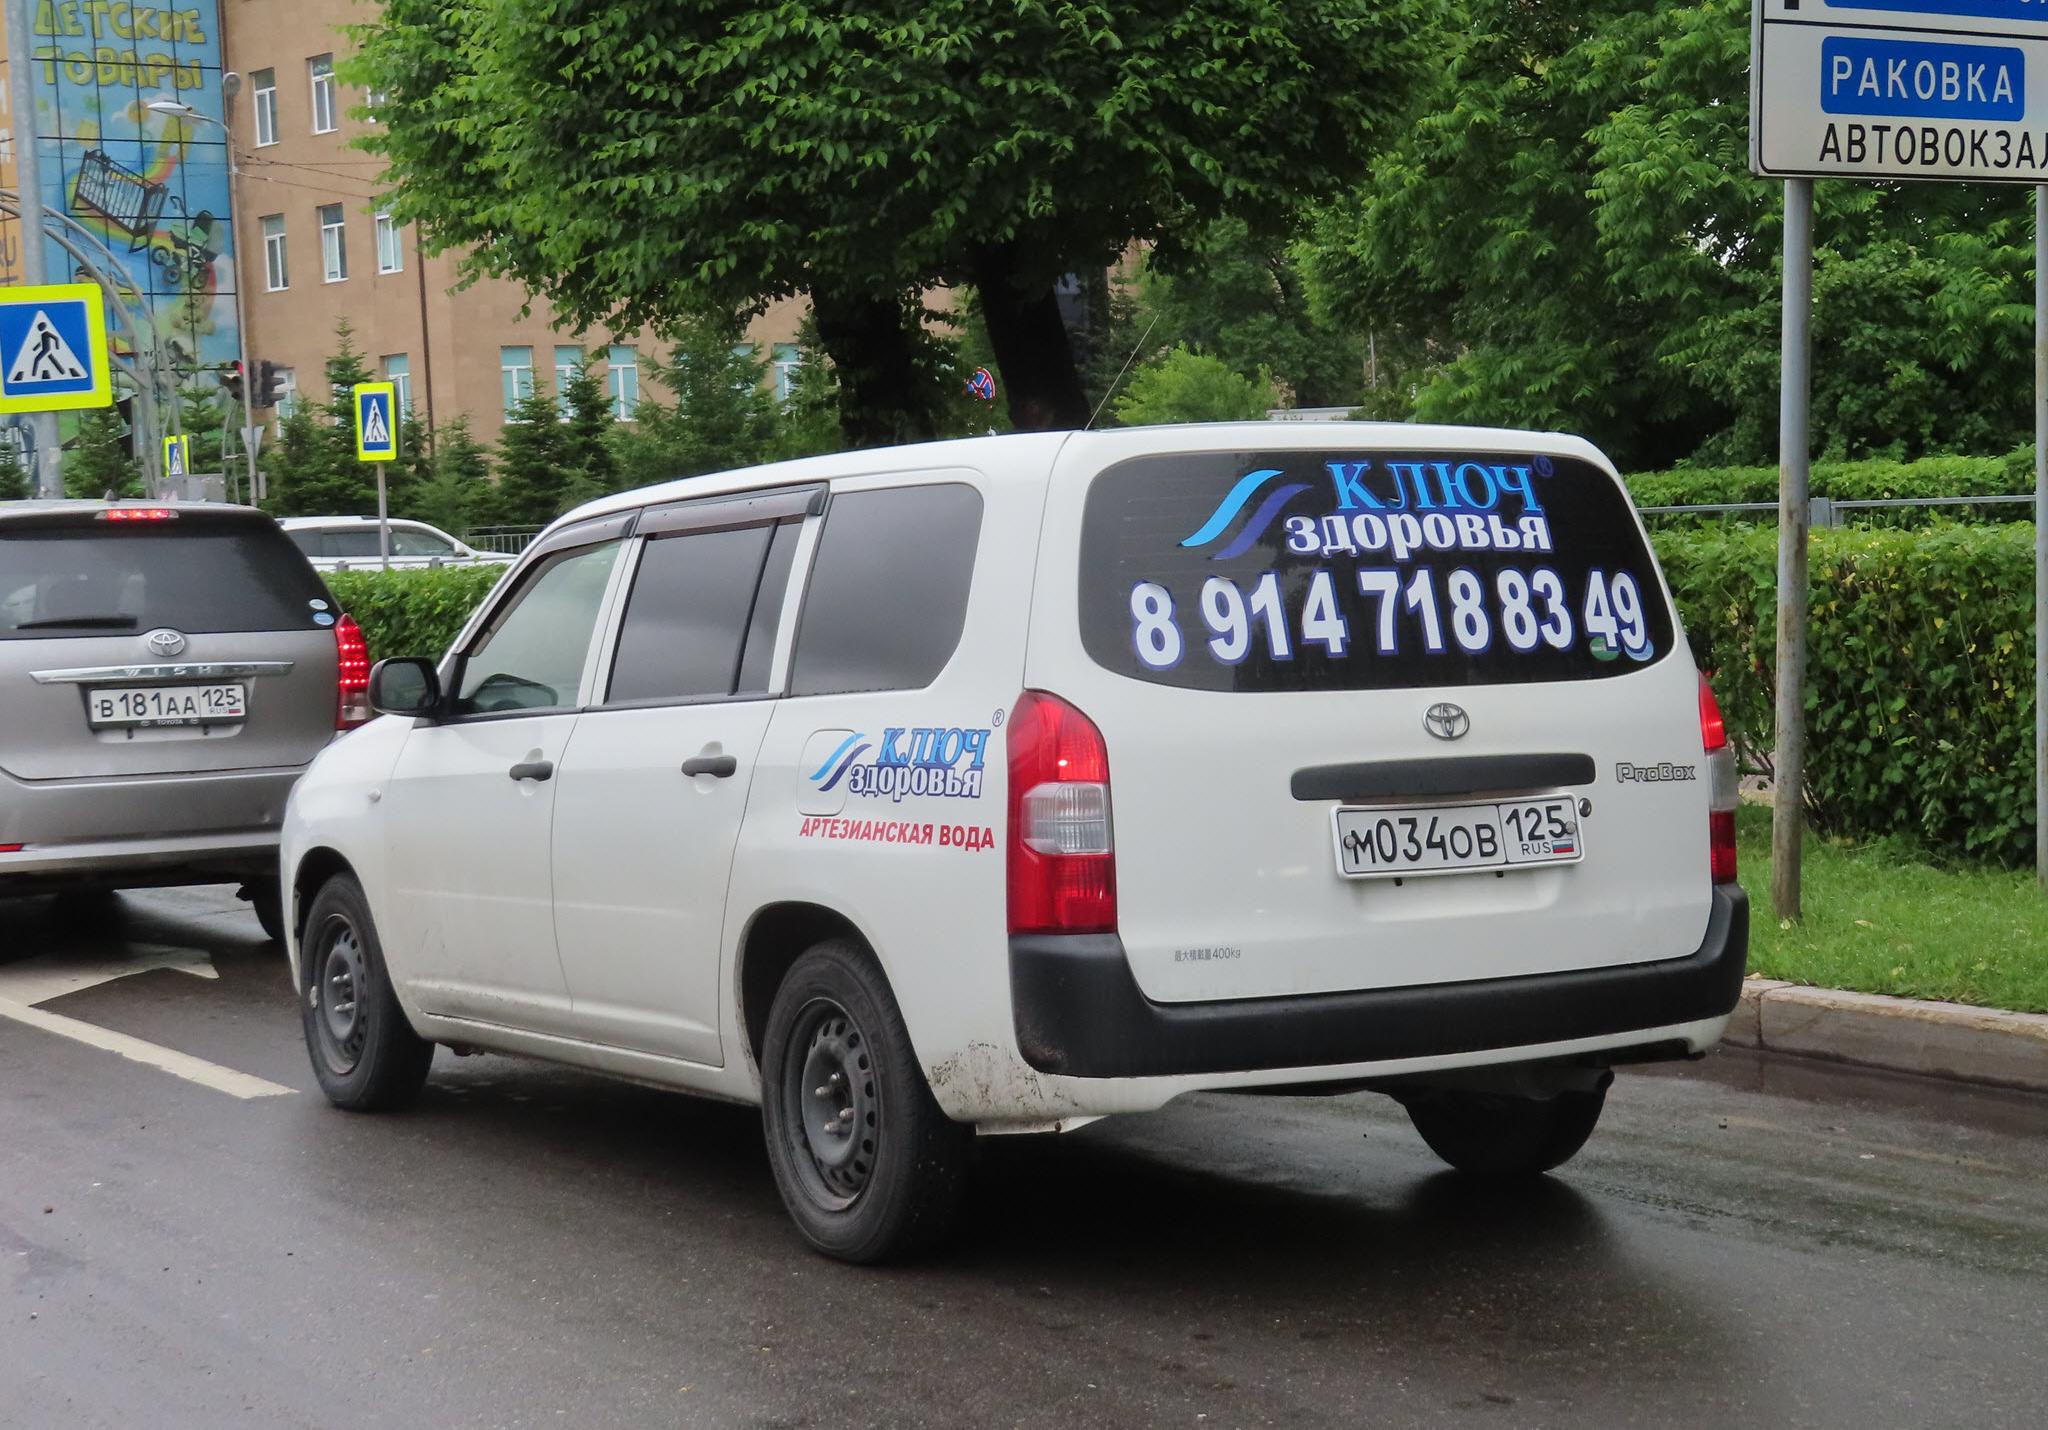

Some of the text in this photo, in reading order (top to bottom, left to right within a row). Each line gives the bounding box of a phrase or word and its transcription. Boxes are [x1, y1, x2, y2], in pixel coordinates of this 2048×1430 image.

[34, 0, 206, 43] ДЕТСКИЕ
[35, 46, 204, 91] ТОВАРЫ
[1831, 55, 2014, 104] РАКОВКА
[1326, 461, 1543, 512] КЛЮЧ
[1130, 579, 1184, 671] 8
[202, 688, 237, 707] 125
[877, 728, 991, 766] КЛЮЧ
[800, 817, 995, 851] АРТЕЗИАНСКАЯ ВОДА
[1505, 805, 1567, 842] 125
[1520, 842, 1551, 856] RUS
